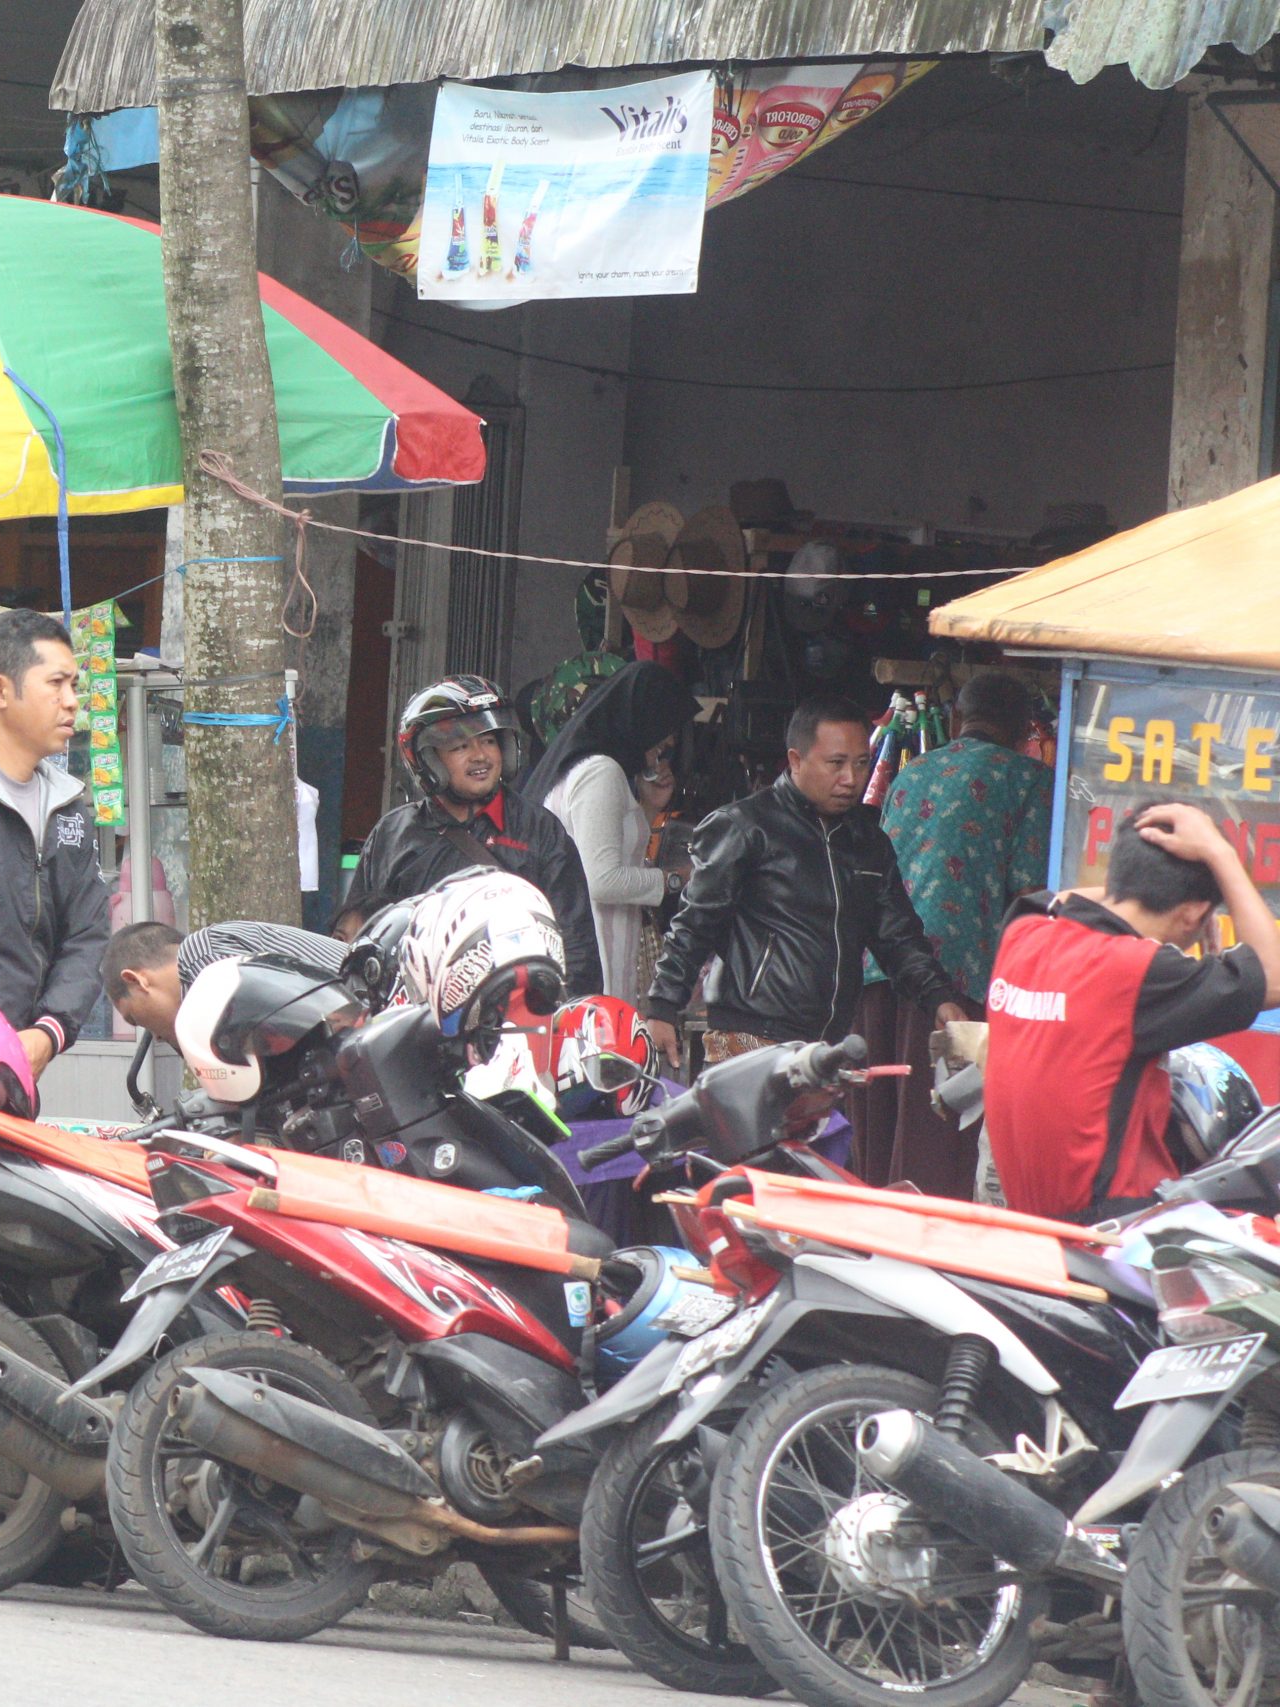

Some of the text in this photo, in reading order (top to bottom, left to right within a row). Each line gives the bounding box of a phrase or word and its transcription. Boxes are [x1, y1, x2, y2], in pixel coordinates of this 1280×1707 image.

[599, 95, 688, 142] Vitalis
[1103, 716, 1276, 792] SATE
[483, 886, 513, 900] GM
[1004, 983, 1066, 1022] YAMAHA
